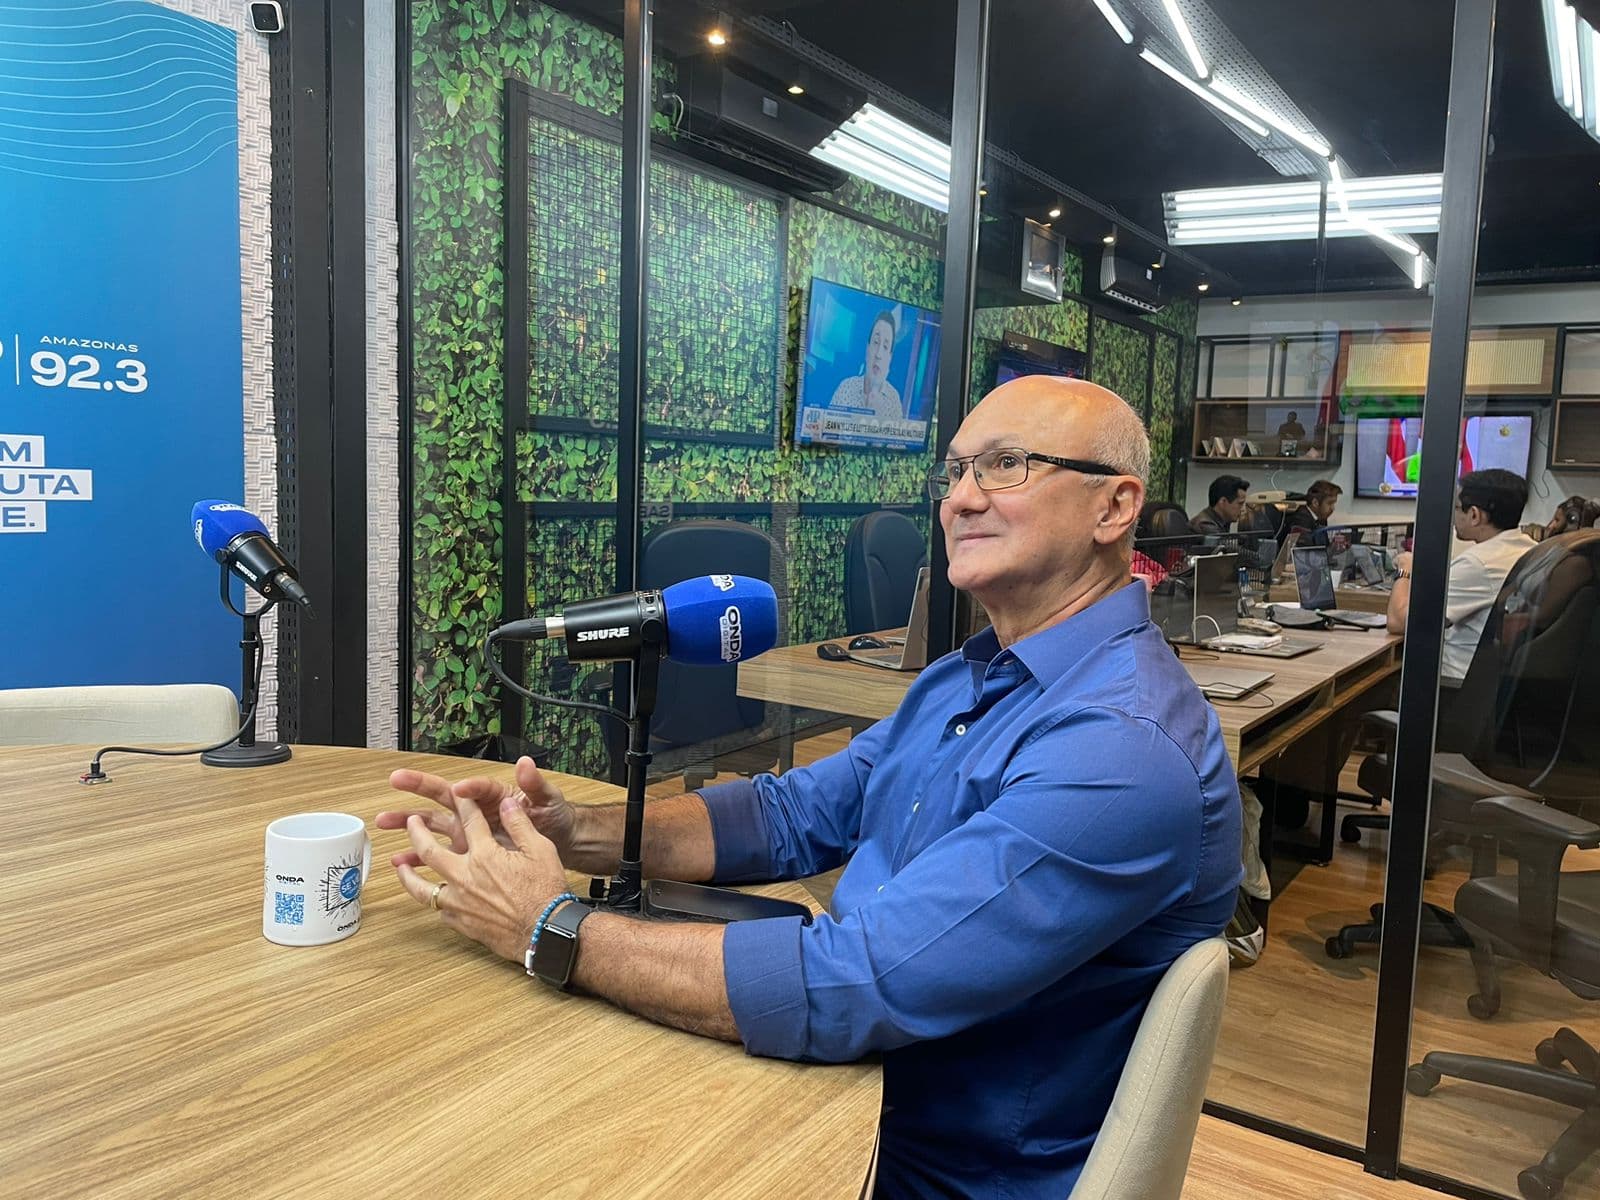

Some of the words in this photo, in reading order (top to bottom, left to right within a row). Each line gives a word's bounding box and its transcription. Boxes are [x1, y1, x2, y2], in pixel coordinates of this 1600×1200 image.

[40, 335, 139, 353] AMAZONAS
[30, 350, 149, 393] 92.3
[2, 506, 35, 527] E.
[576, 626, 630, 642] SHURE
[728, 608, 741, 661] ONDA
[275, 874, 305, 883] ONDA
